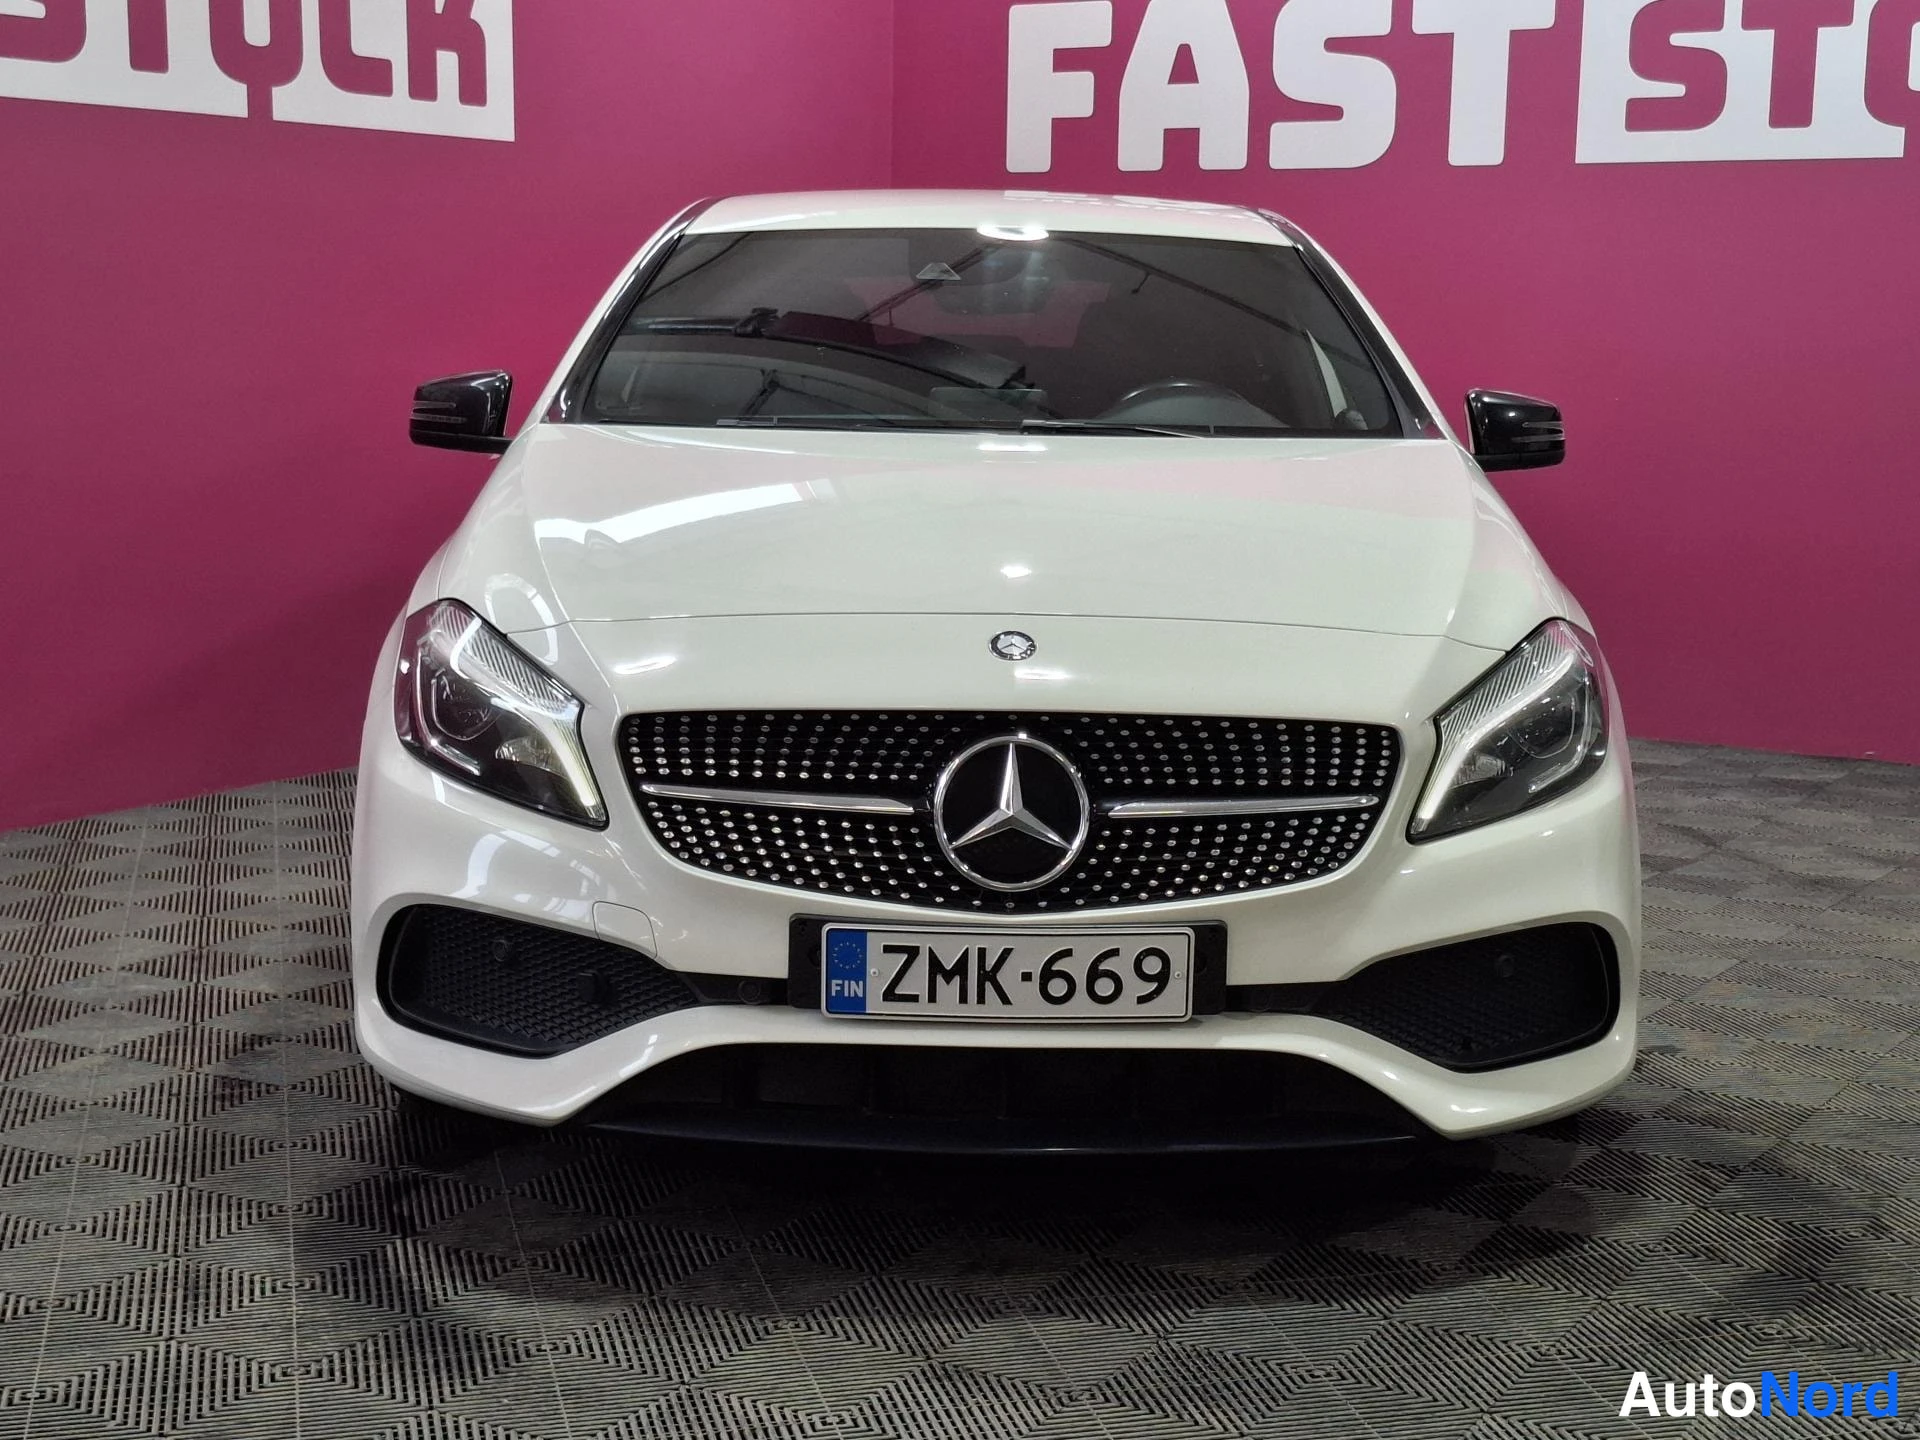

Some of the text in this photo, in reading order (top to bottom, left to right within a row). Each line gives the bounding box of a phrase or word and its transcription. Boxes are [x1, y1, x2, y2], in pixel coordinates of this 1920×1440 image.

[1006, 0, 1556, 172] FAST
[831, 980, 864, 998] FIN
[881, 944, 1172, 1006] ZMK-669
